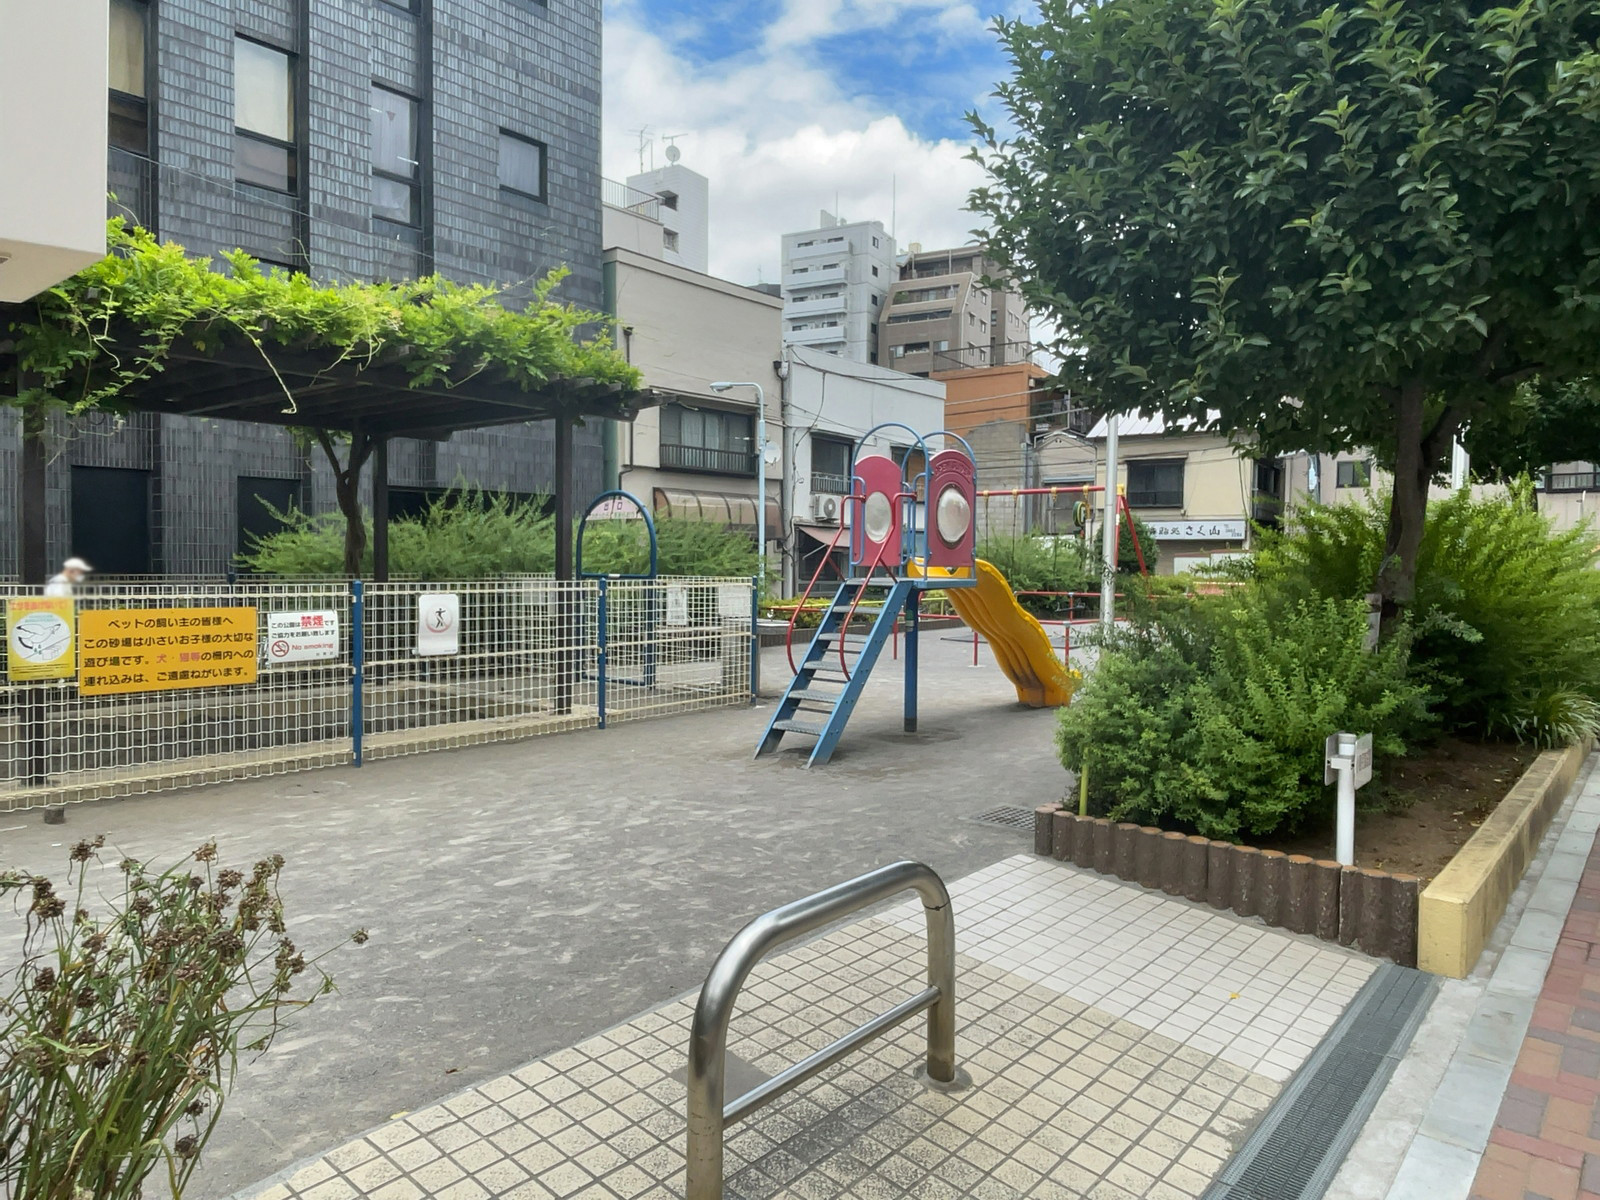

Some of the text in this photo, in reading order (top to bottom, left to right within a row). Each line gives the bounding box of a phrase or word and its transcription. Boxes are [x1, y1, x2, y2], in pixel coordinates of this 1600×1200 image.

[1185, 525, 1221, 536] さく山
[107, 616, 234, 630] ペットの飼い主の皆様へ
[84, 632, 254, 649] この砂場は小さいお子様の大切な
[84, 667, 248, 687] 連れ込みは、ご遠慮ねがいます。
